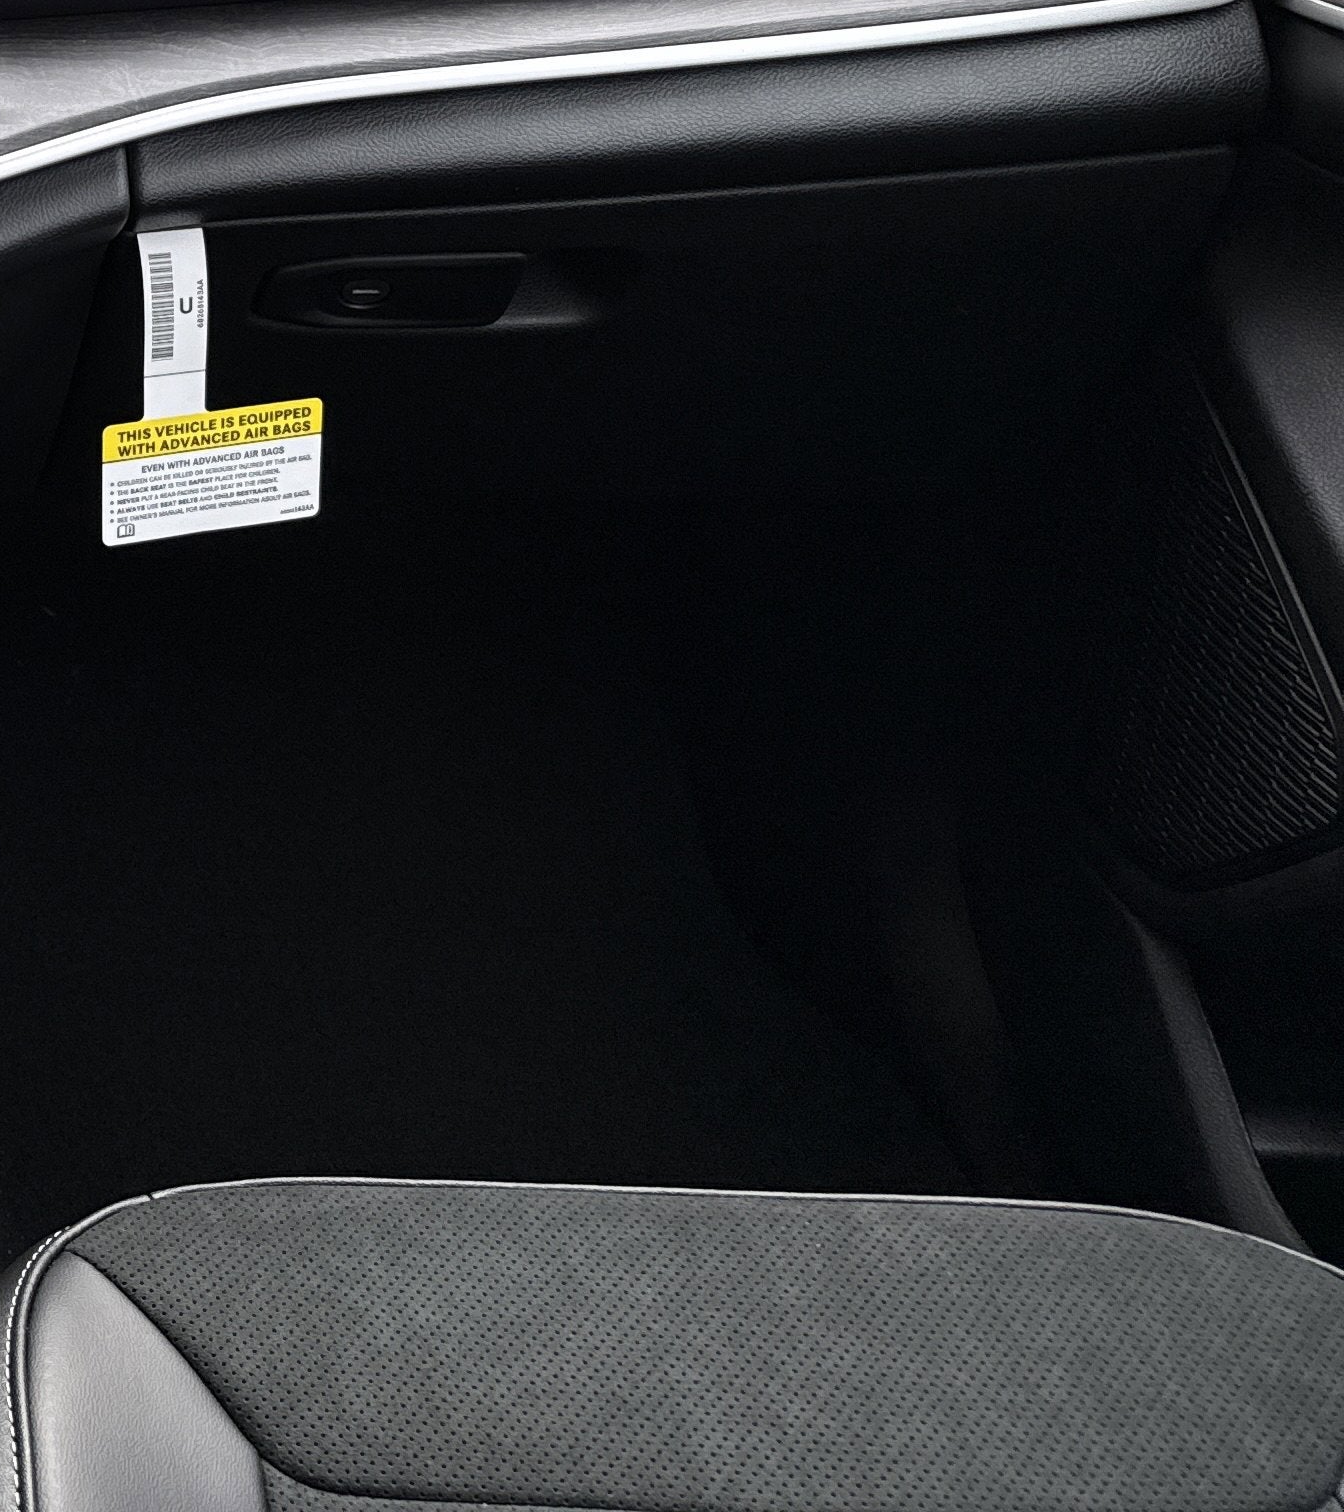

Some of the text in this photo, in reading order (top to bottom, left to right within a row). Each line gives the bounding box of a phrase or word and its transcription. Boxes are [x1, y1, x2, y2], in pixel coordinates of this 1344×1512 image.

[179, 297, 193, 314] U
[117, 406, 312, 443] THIS VEHICLE IS EQUIPPED
[118, 420, 311, 457] WITH ADVANCED AIR BAGS
[141, 446, 285, 474] EVEN WITH ADVANCED AIR BAGS
